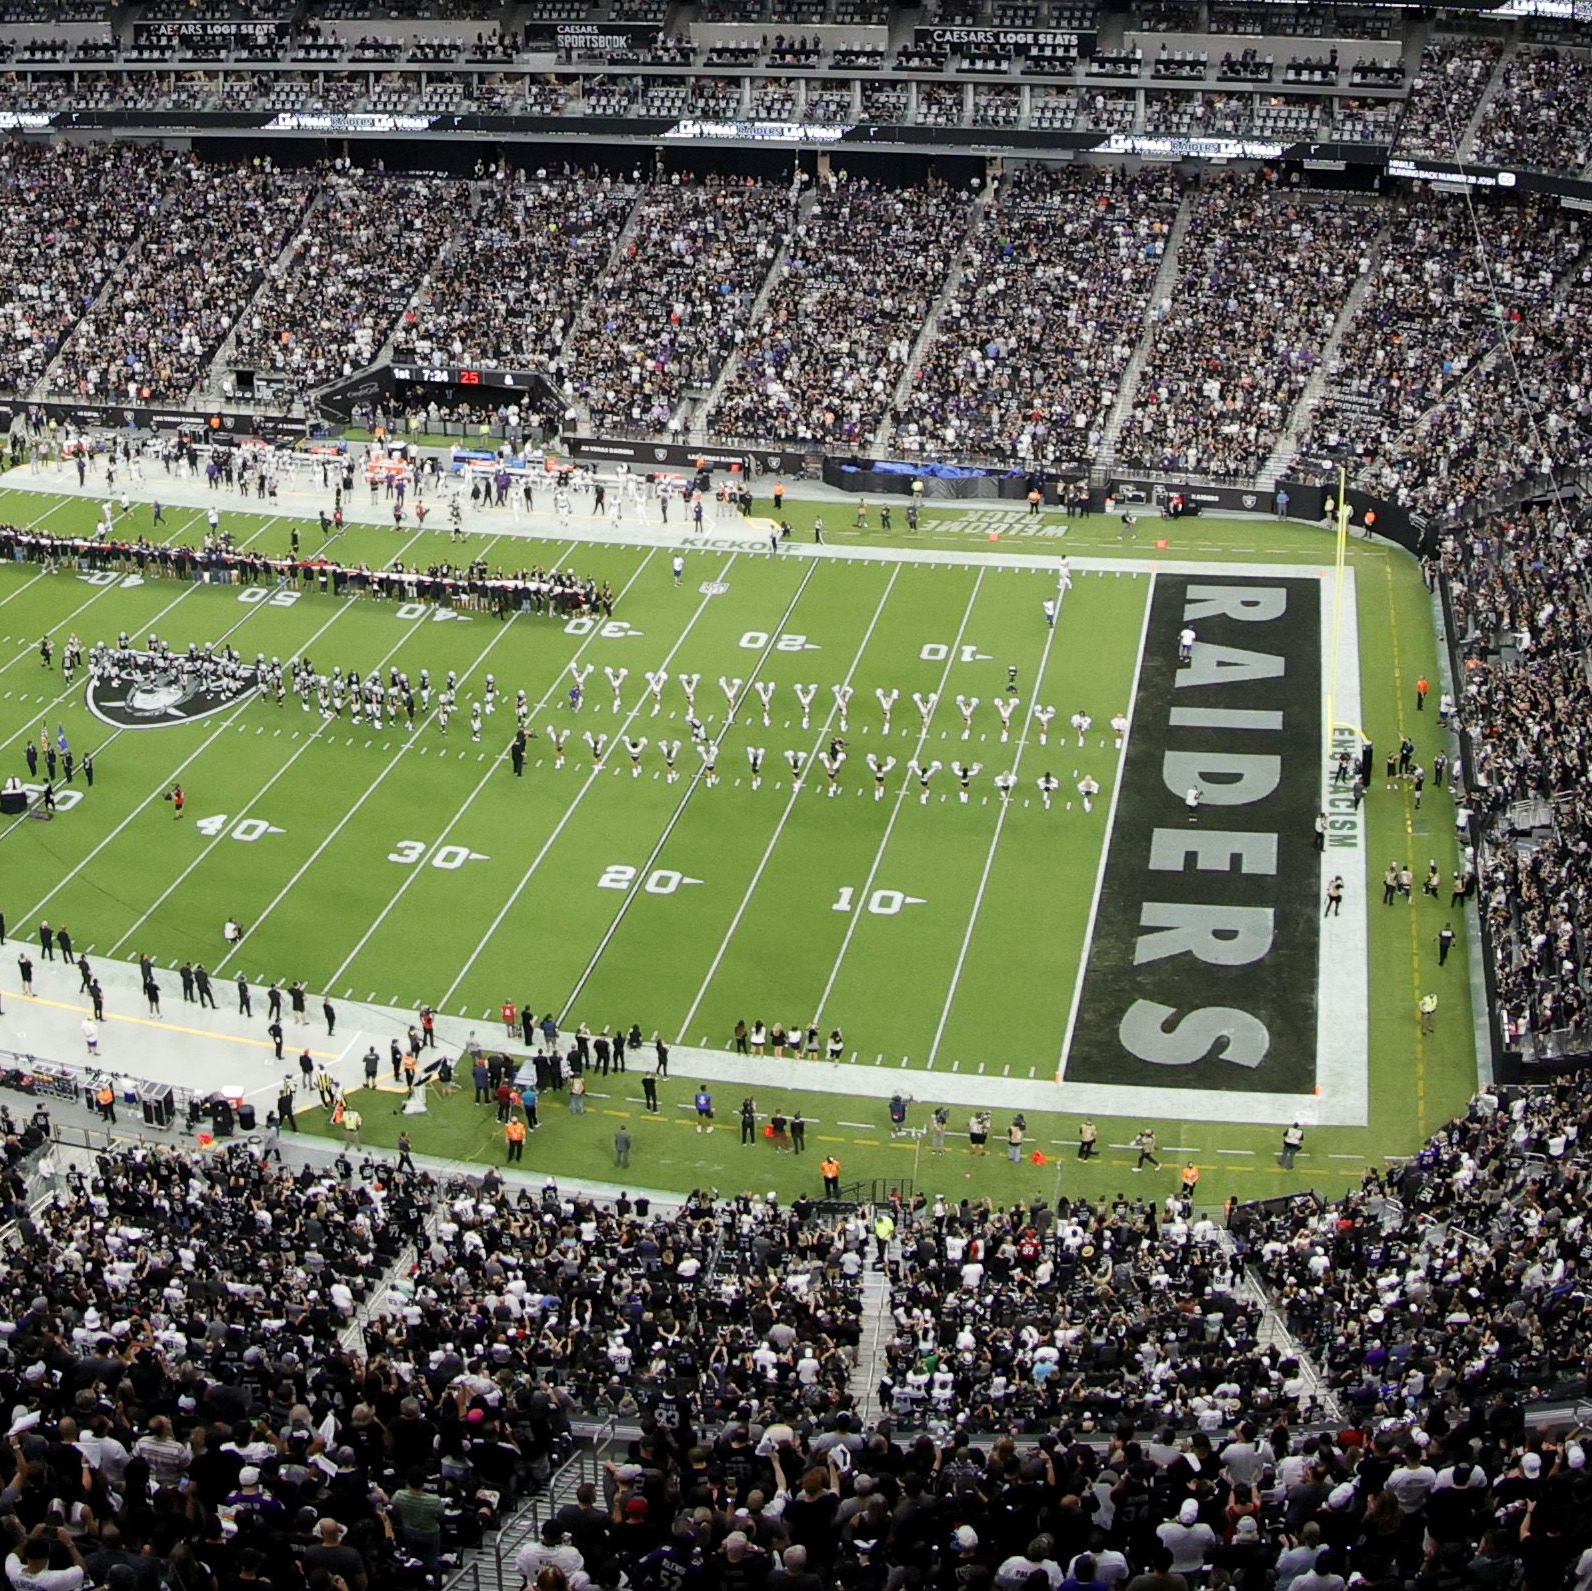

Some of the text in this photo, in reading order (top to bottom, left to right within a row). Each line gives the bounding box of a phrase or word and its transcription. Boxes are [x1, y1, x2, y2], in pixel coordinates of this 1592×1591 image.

[1513, 0, 1535, 11] LAS
[1536, 2, 1572, 14] VEGAS
[557, 25, 598, 34] CAESARS
[933, 30, 1079, 45] CAESARS LOGE SEATS
[557, 34, 627, 49] SPORTSBOOK
[279, 117, 429, 128] LAS VEGAS LAS VEGAS
[679, 124, 842, 138] LAS VEGAS RAIDERS LAS VEGAS
[1110, 139, 1282, 155] LAS VEGAS RAIDERS LAS VEGAS
[1389, 168, 1496, 185] RUNNING BACK NUMBER JOSH
[1501, 175, 1513, 184] CC
[393, 369, 410, 381] 1st
[422, 369, 449, 382] 7:24
[460, 372, 479, 384] 25
[922, 520, 1069, 537] WELCOME
[87, 571, 145, 588] 40
[237, 587, 302, 607] 50
[395, 603, 458, 621] 40
[564, 618, 631, 638] 30
[738, 631, 807, 651] 20
[919, 644, 977, 662] 10
[196, 814, 269, 841] 40
[1118, 584, 1287, 1068] RAIDERS
[387, 840, 471, 870] 30
[597, 865, 682, 894] 20
[832, 886, 905, 915] 10
